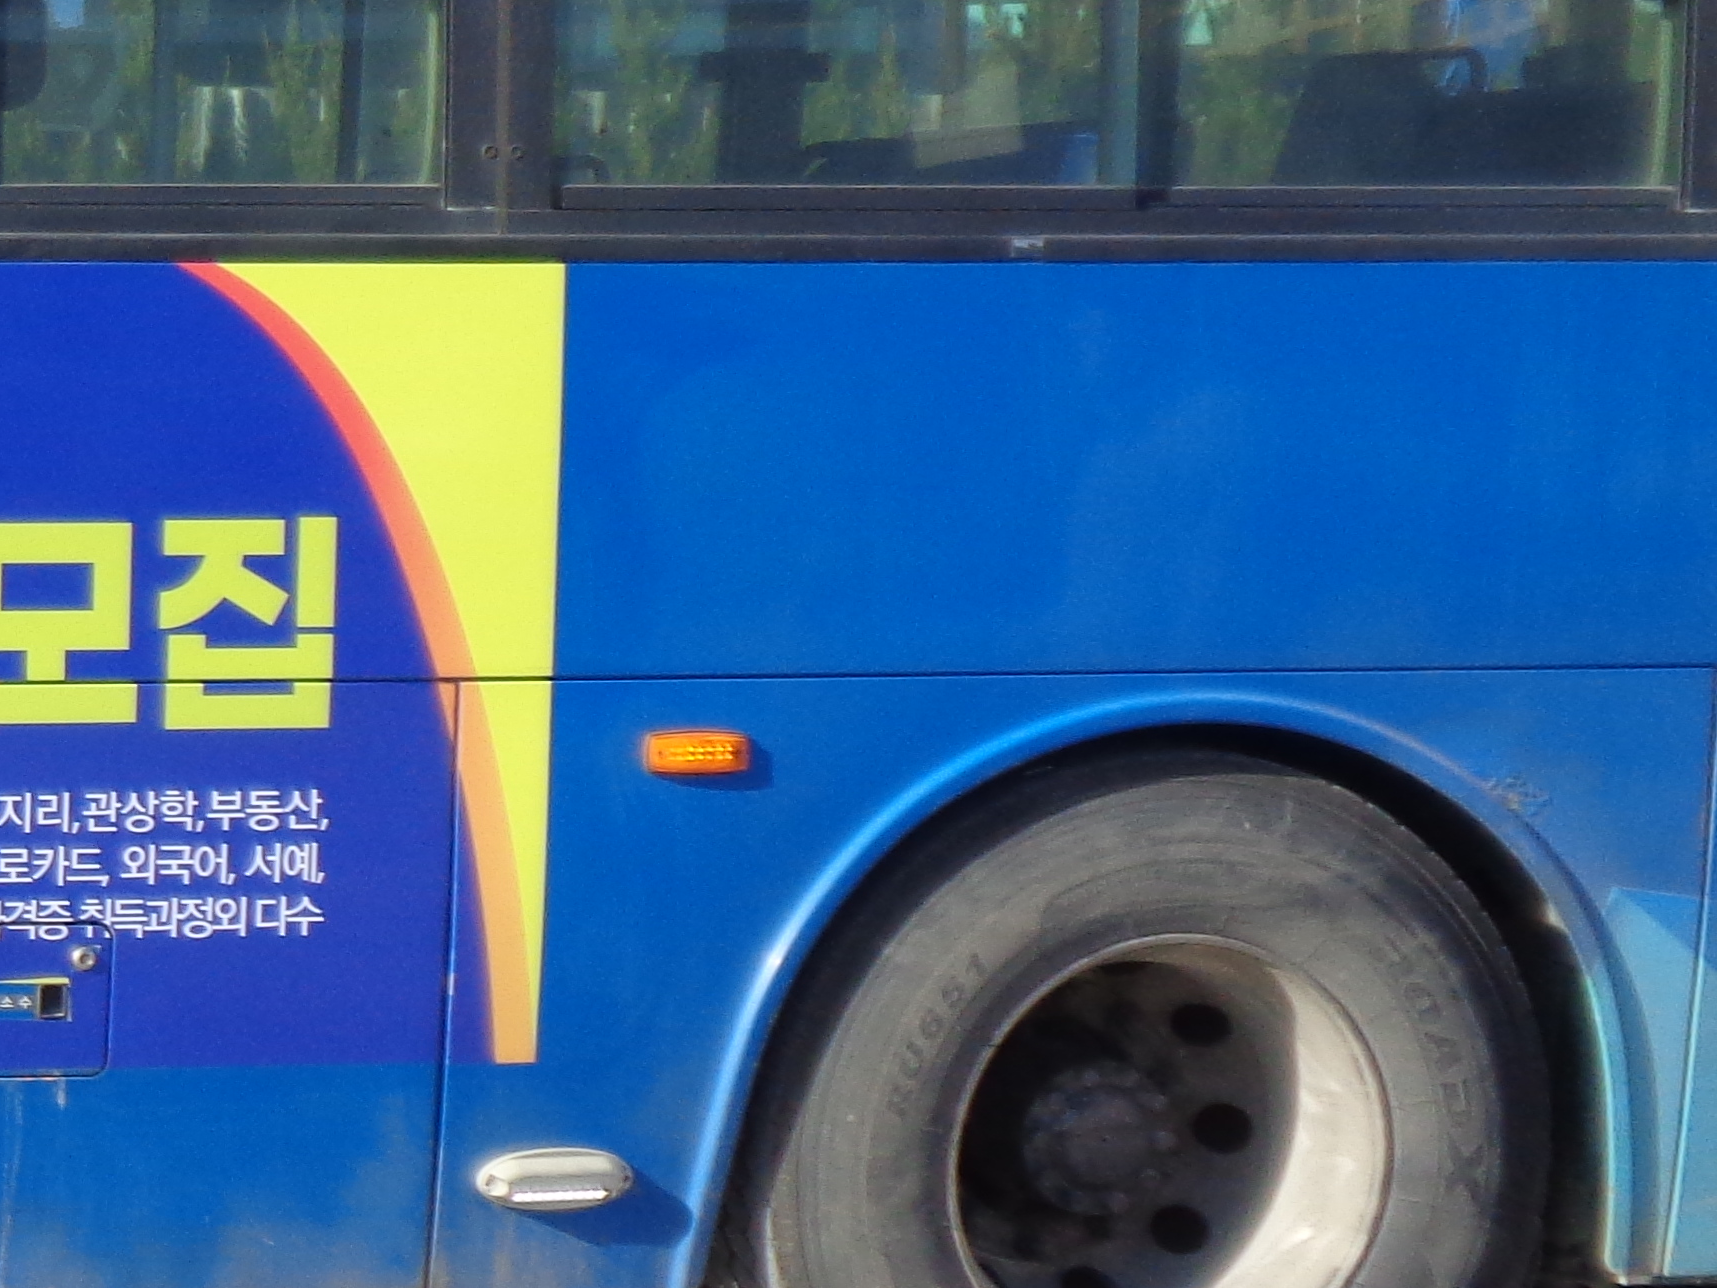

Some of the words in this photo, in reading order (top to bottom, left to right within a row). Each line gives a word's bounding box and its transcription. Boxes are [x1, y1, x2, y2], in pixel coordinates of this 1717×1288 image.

[119, 843, 236, 885] 외국어,
[244, 842, 325, 884] 서예,
[254, 895, 325, 936] 다수
